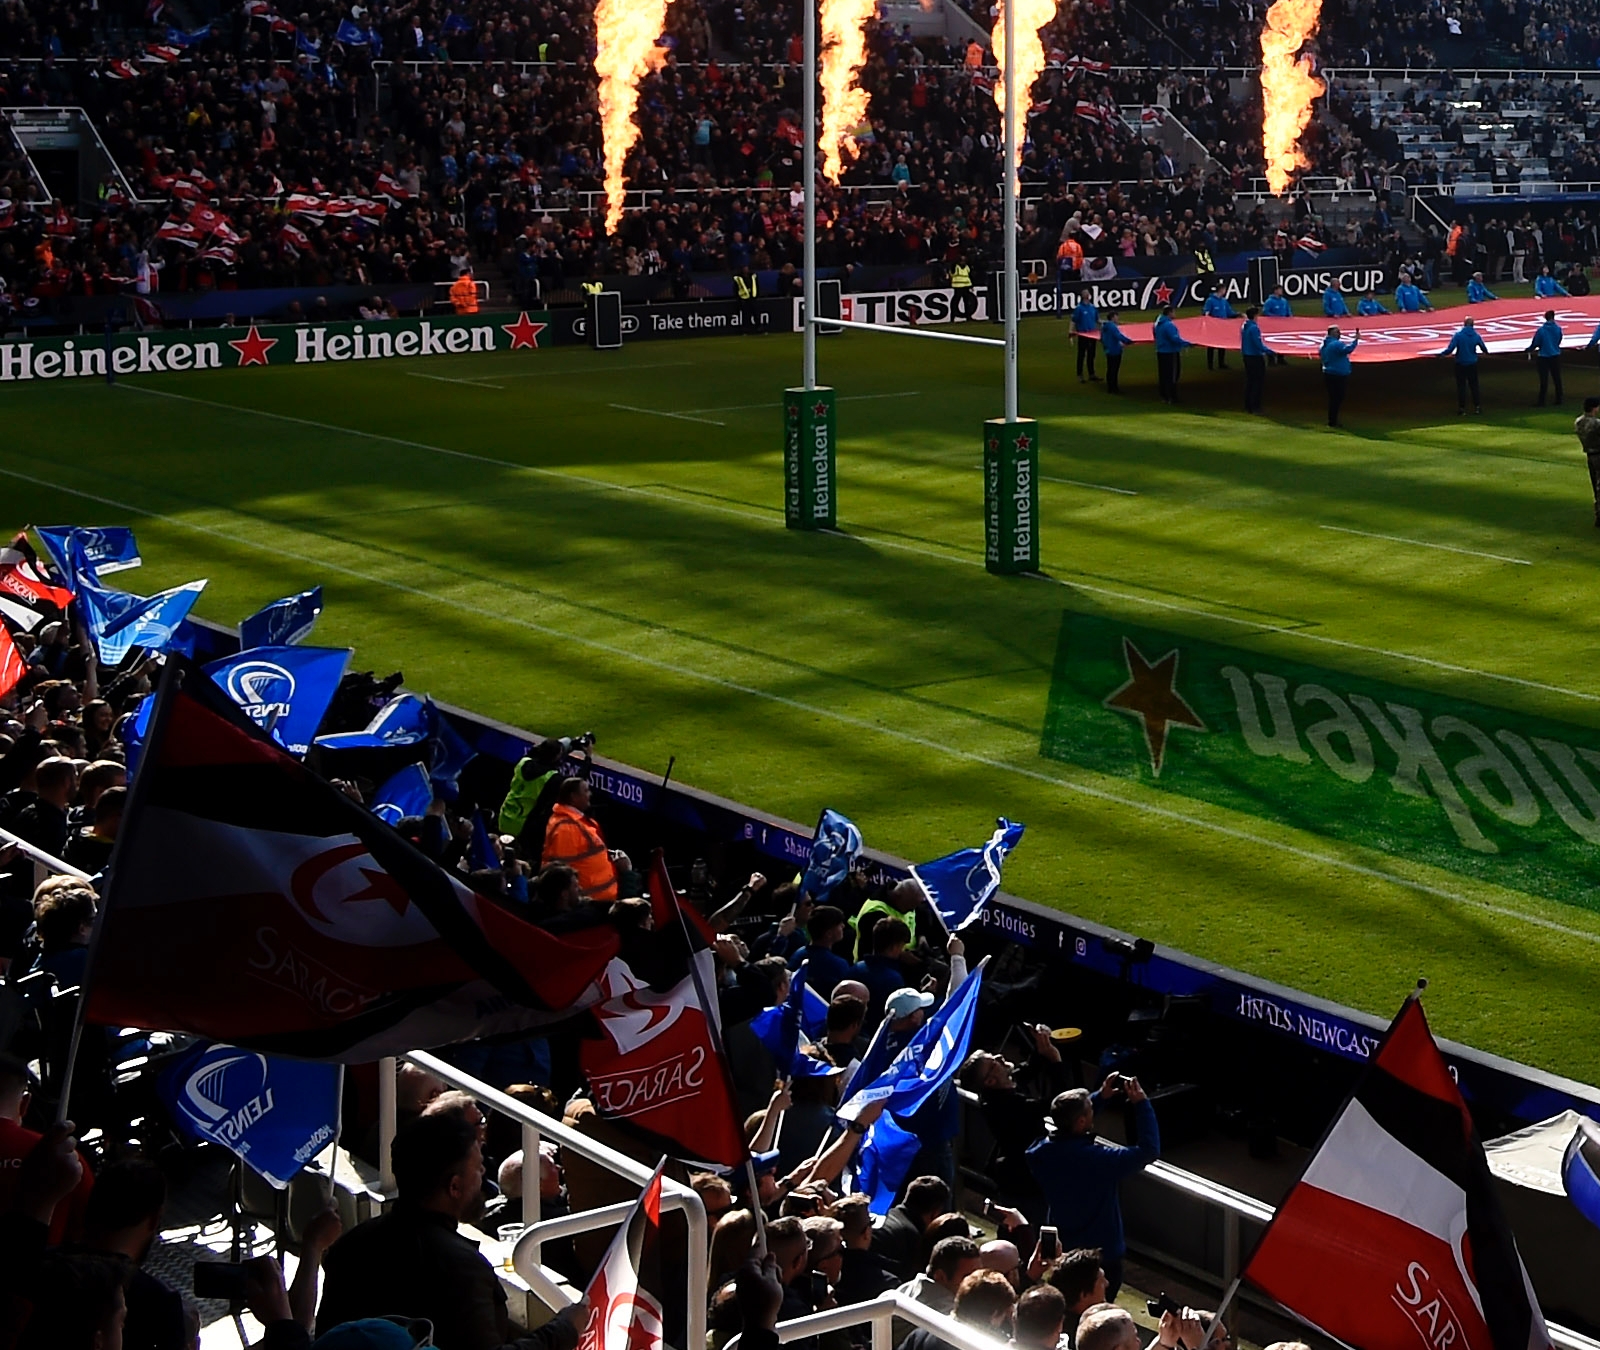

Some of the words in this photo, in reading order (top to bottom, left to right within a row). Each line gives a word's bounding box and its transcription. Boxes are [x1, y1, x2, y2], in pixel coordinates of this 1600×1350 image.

[1019, 285, 1138, 313] Heinken
[1339, 270, 1384, 295] CUP
[650, 314, 683, 331] Take
[688, 312, 727, 329] them
[730, 310, 743, 326] al
[0, 336, 223, 380] Heineken
[294, 322, 497, 363] Heineken
[813, 425, 832, 520] Heineken
[1013, 458, 1032, 562] Heineken
[617, 779, 643, 804] 2019
[993, 909, 1036, 938] Stories
[1237, 994, 1296, 1032] FINALS
